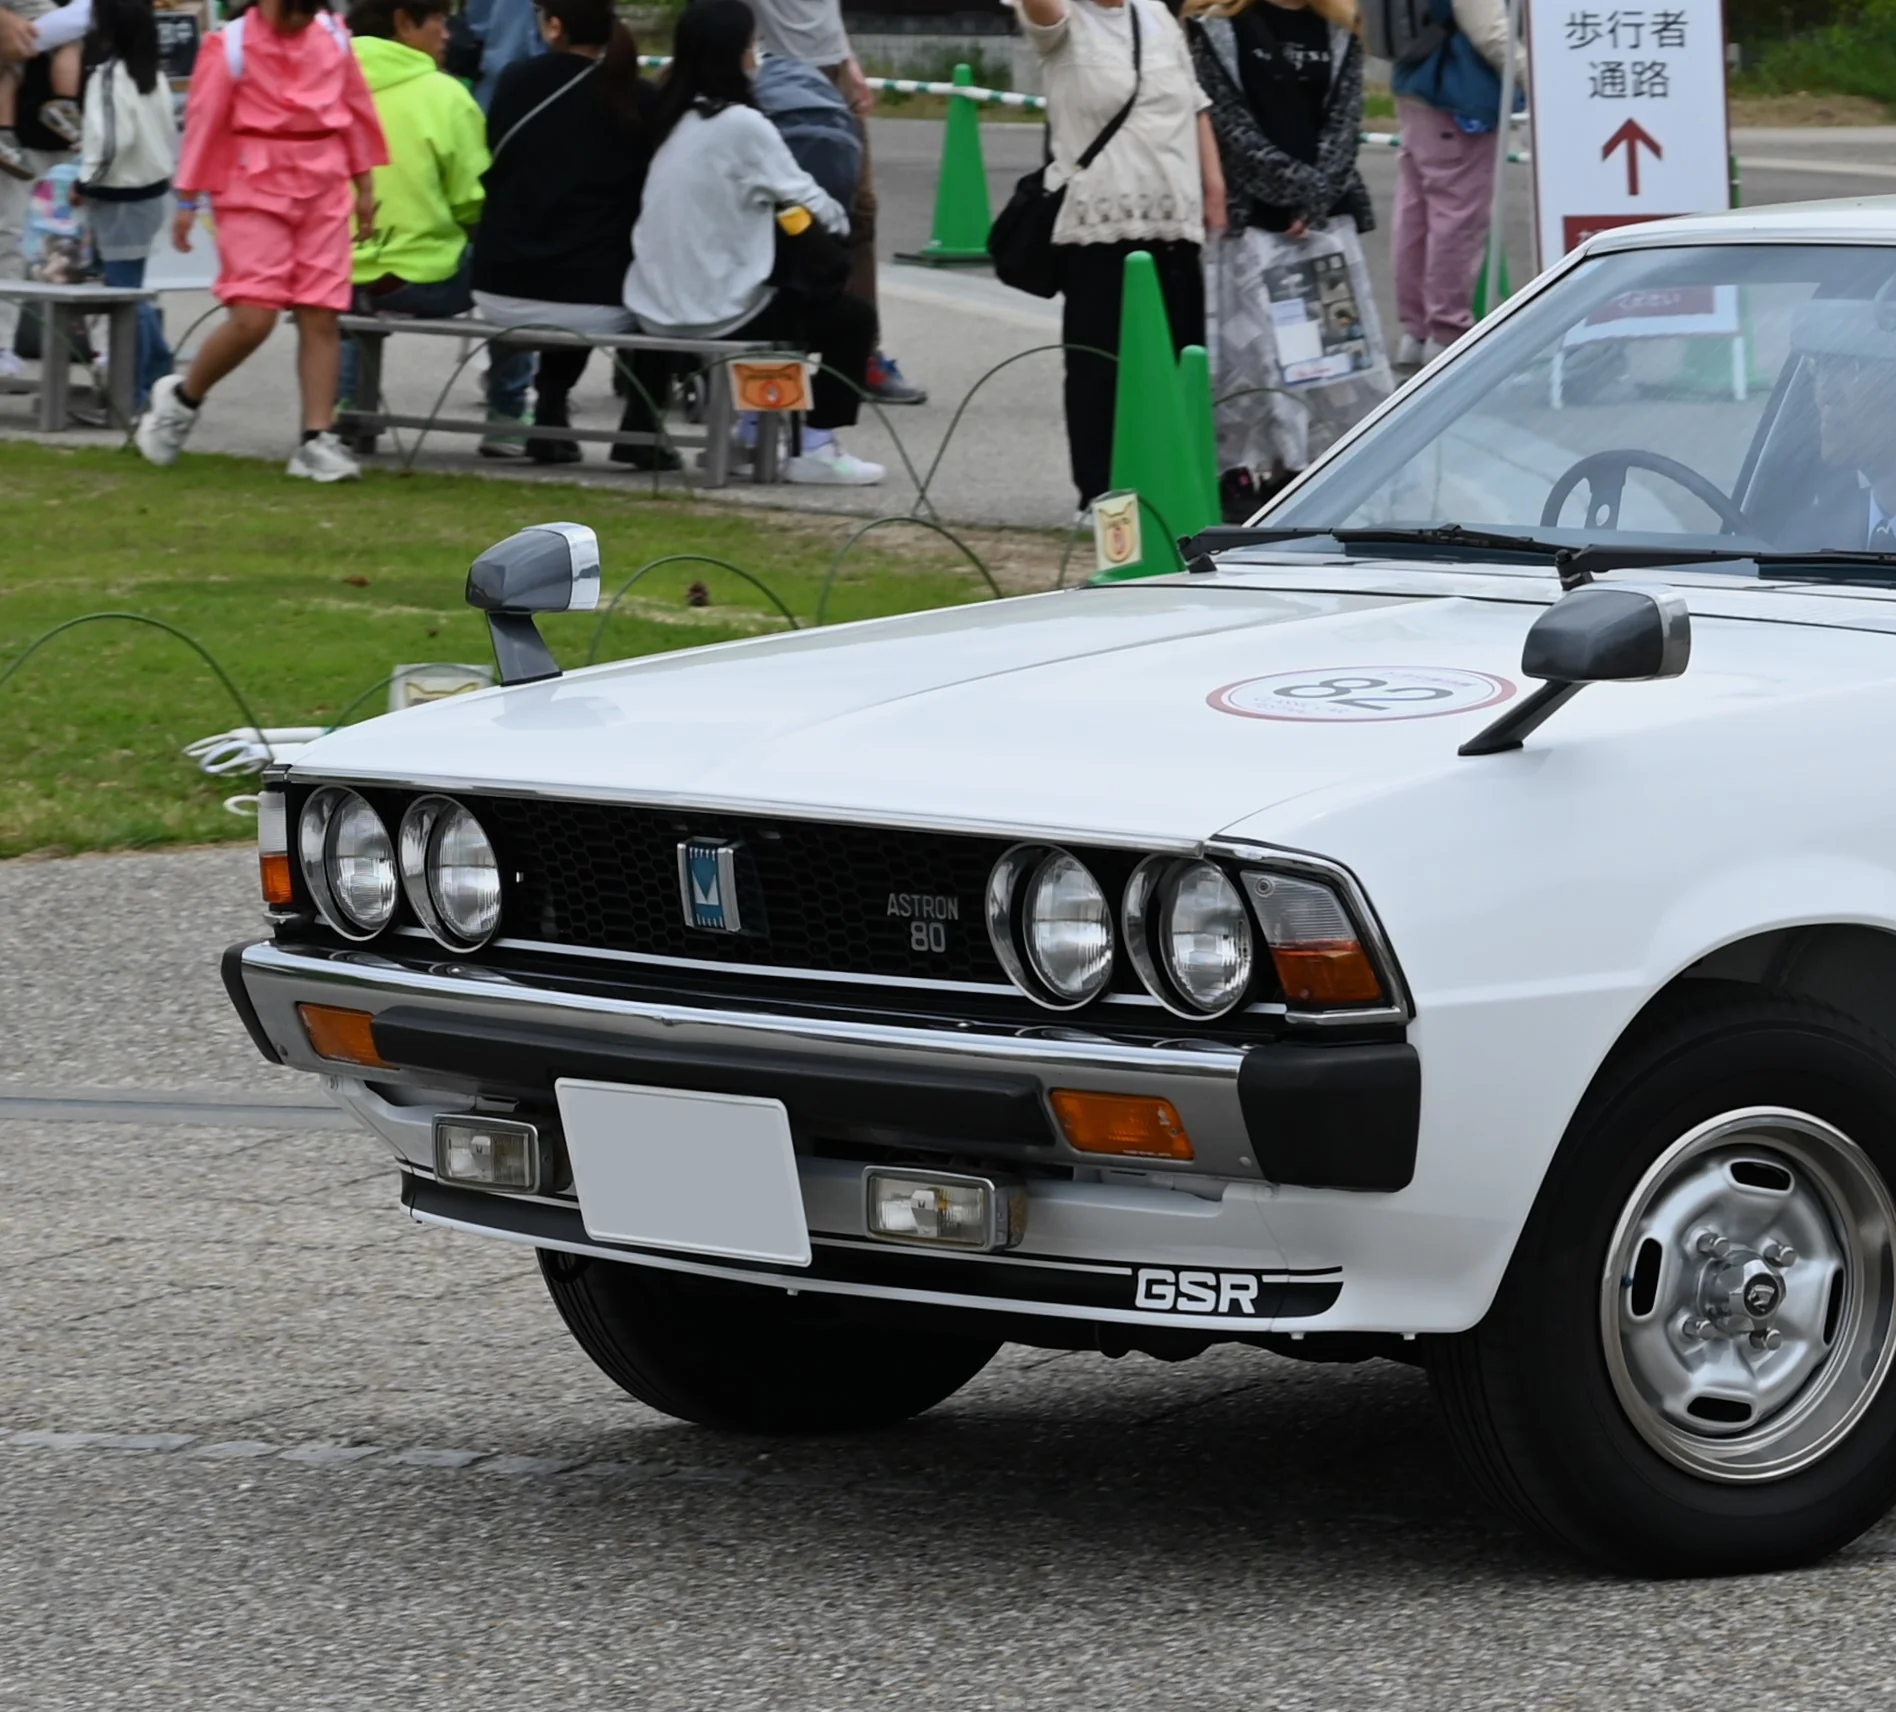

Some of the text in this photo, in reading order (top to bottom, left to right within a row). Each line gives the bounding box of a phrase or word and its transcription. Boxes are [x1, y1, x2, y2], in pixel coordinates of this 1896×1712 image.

[1564, 10, 1689, 50] 歩行者
[1587, 60, 1671, 100] 通路
[1272, 676, 1455, 712] 82
[886, 892, 960, 921] ASTRON
[909, 920, 946, 953] 80
[1134, 1267, 1259, 1315] GSR
